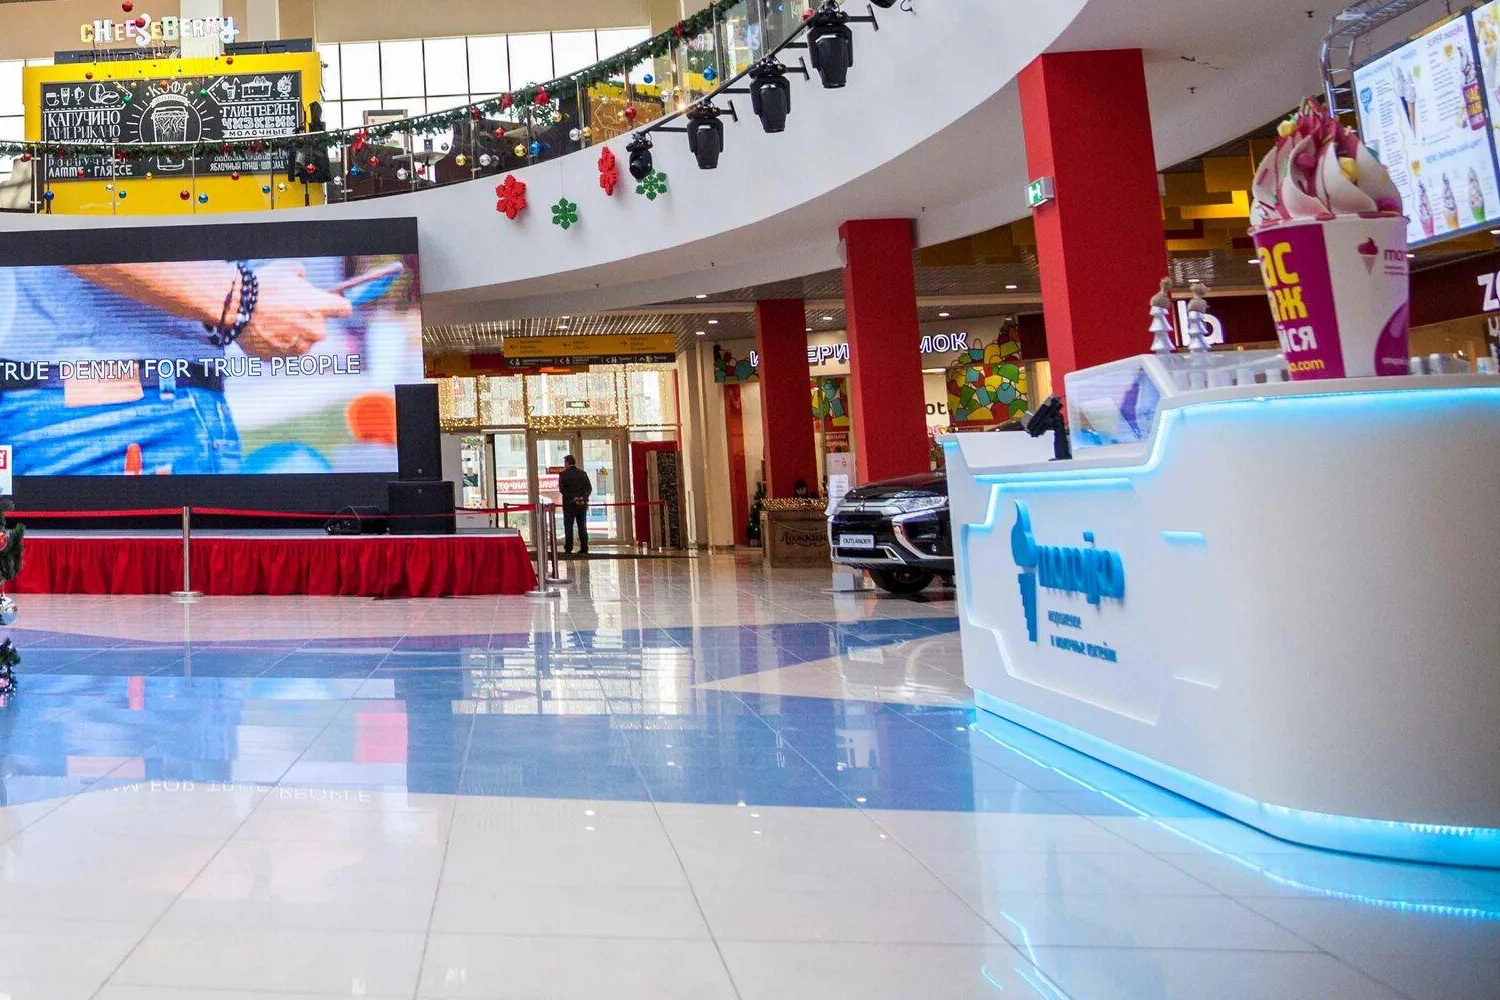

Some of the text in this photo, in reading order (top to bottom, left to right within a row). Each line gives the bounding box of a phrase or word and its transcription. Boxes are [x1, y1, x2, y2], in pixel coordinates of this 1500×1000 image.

[222, 103, 291, 118] ГЛИНТВЕЙН
[48, 111, 121, 128] КАПУЧИНО
[49, 125, 121, 140] АМЕРИКАНО
[228, 129, 287, 137] МОЛОЧНЫЕ
[94, 164, 133, 177] ГЛЯССЕ
[58, 359, 135, 380] DENIM
[143, 357, 191, 379] FOR
[198, 357, 262, 378] TRUE
[270, 353, 362, 376] PEOPLE
[842, 537, 872, 545] OUTLANDER
